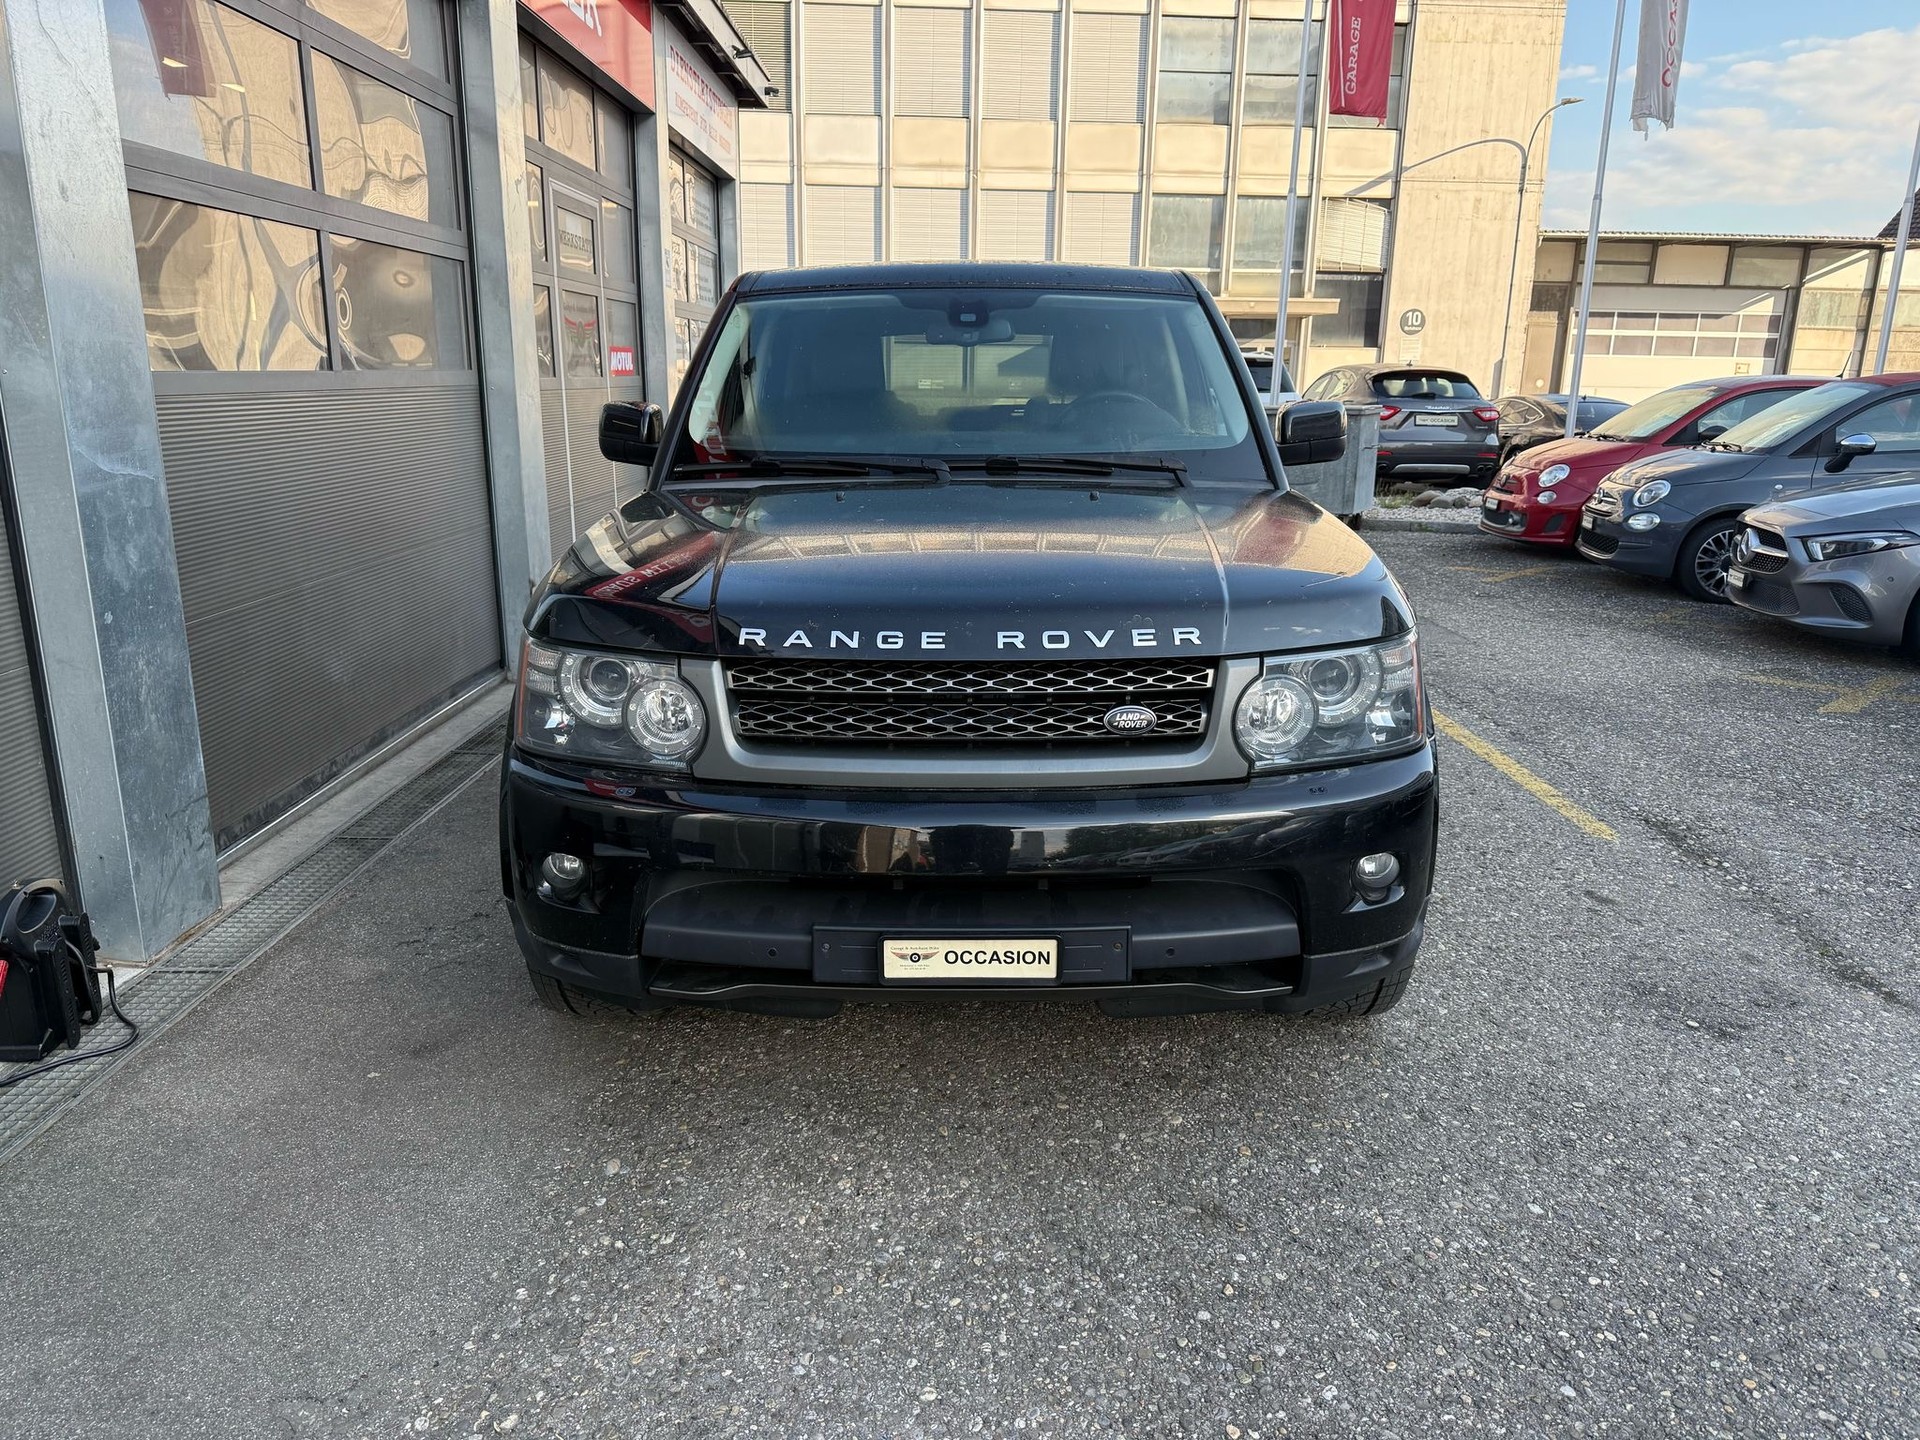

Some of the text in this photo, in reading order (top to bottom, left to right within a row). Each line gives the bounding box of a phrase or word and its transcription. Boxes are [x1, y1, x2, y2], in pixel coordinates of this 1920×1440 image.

[1344, 16, 1361, 94] GARAGE
[1405, 310, 1422, 326] 10
[610, 351, 634, 371] MOTUL
[738, 627, 1203, 650] RANGE ROVER
[1115, 712, 1140, 721] LAND
[1117, 720, 1148, 729] ROVER
[944, 950, 1051, 965] OCCASION
